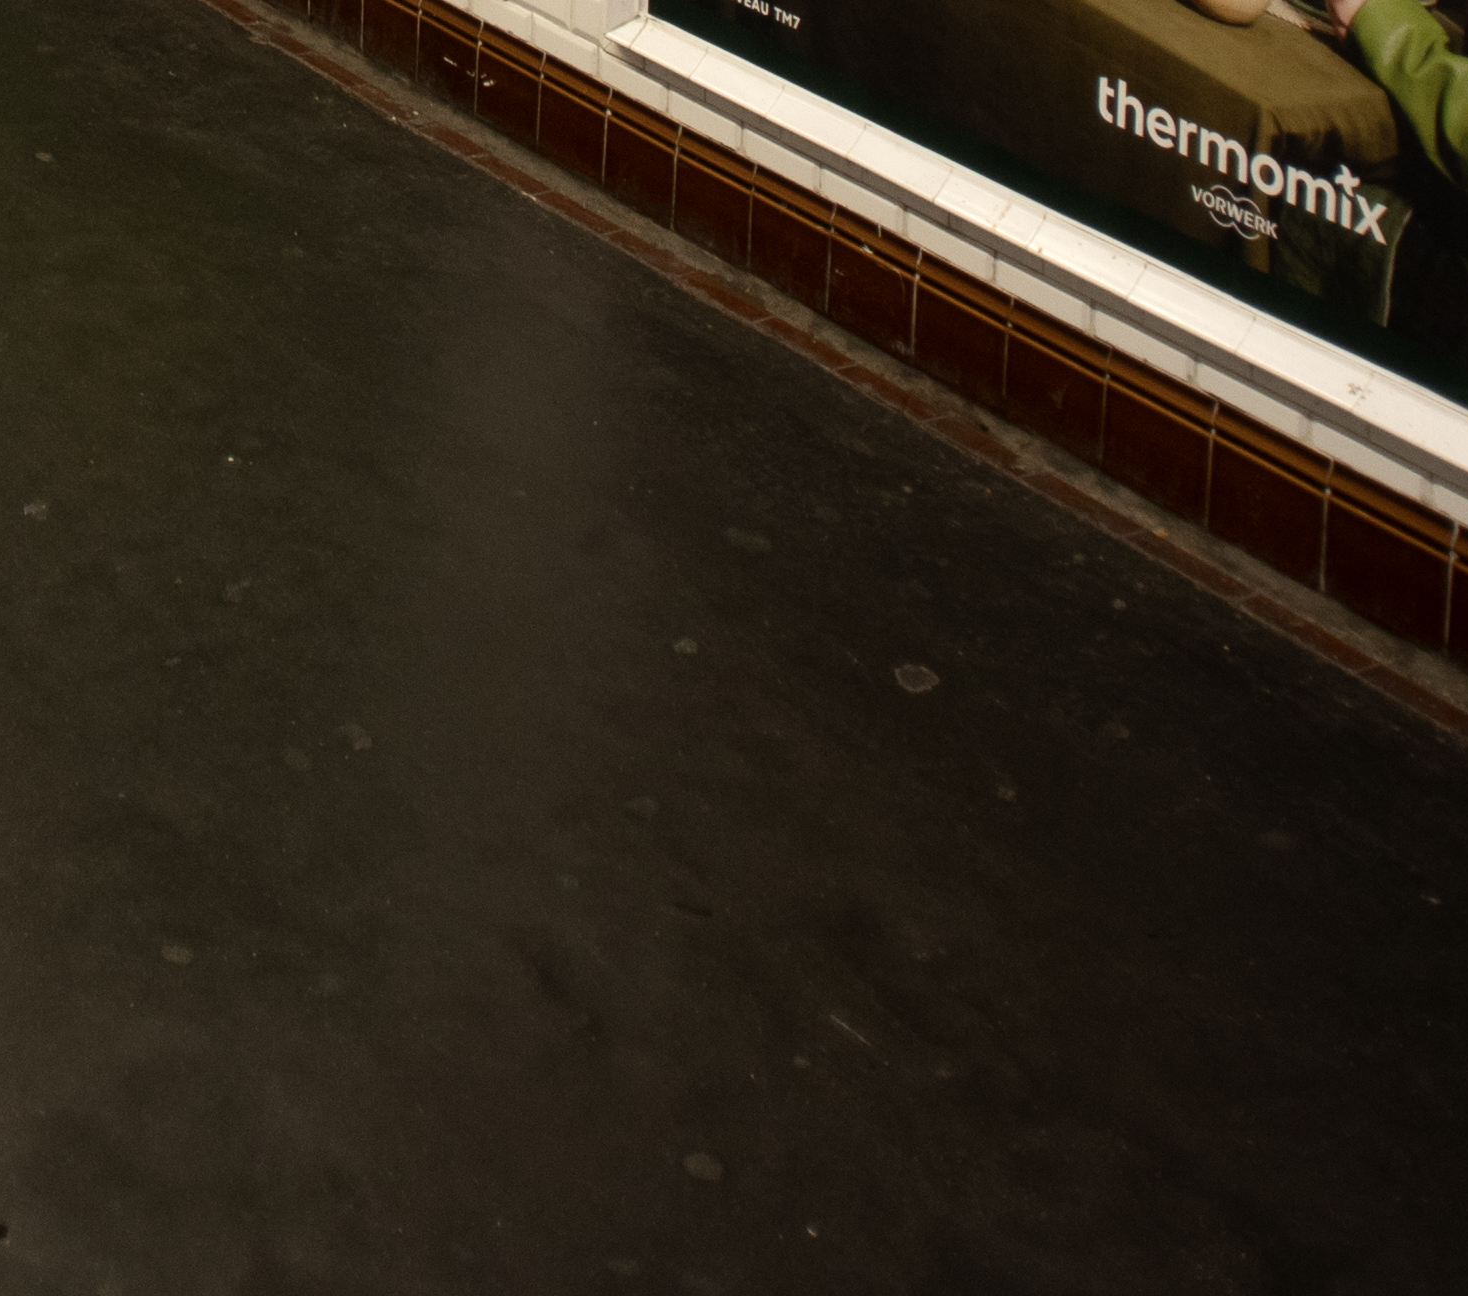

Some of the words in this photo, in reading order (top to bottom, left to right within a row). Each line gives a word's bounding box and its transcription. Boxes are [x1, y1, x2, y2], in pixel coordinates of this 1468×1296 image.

[774, 6, 800, 29] TM7
[1097, 76, 1387, 245] thermomix
[1191, 185, 1278, 240] VORWERK
